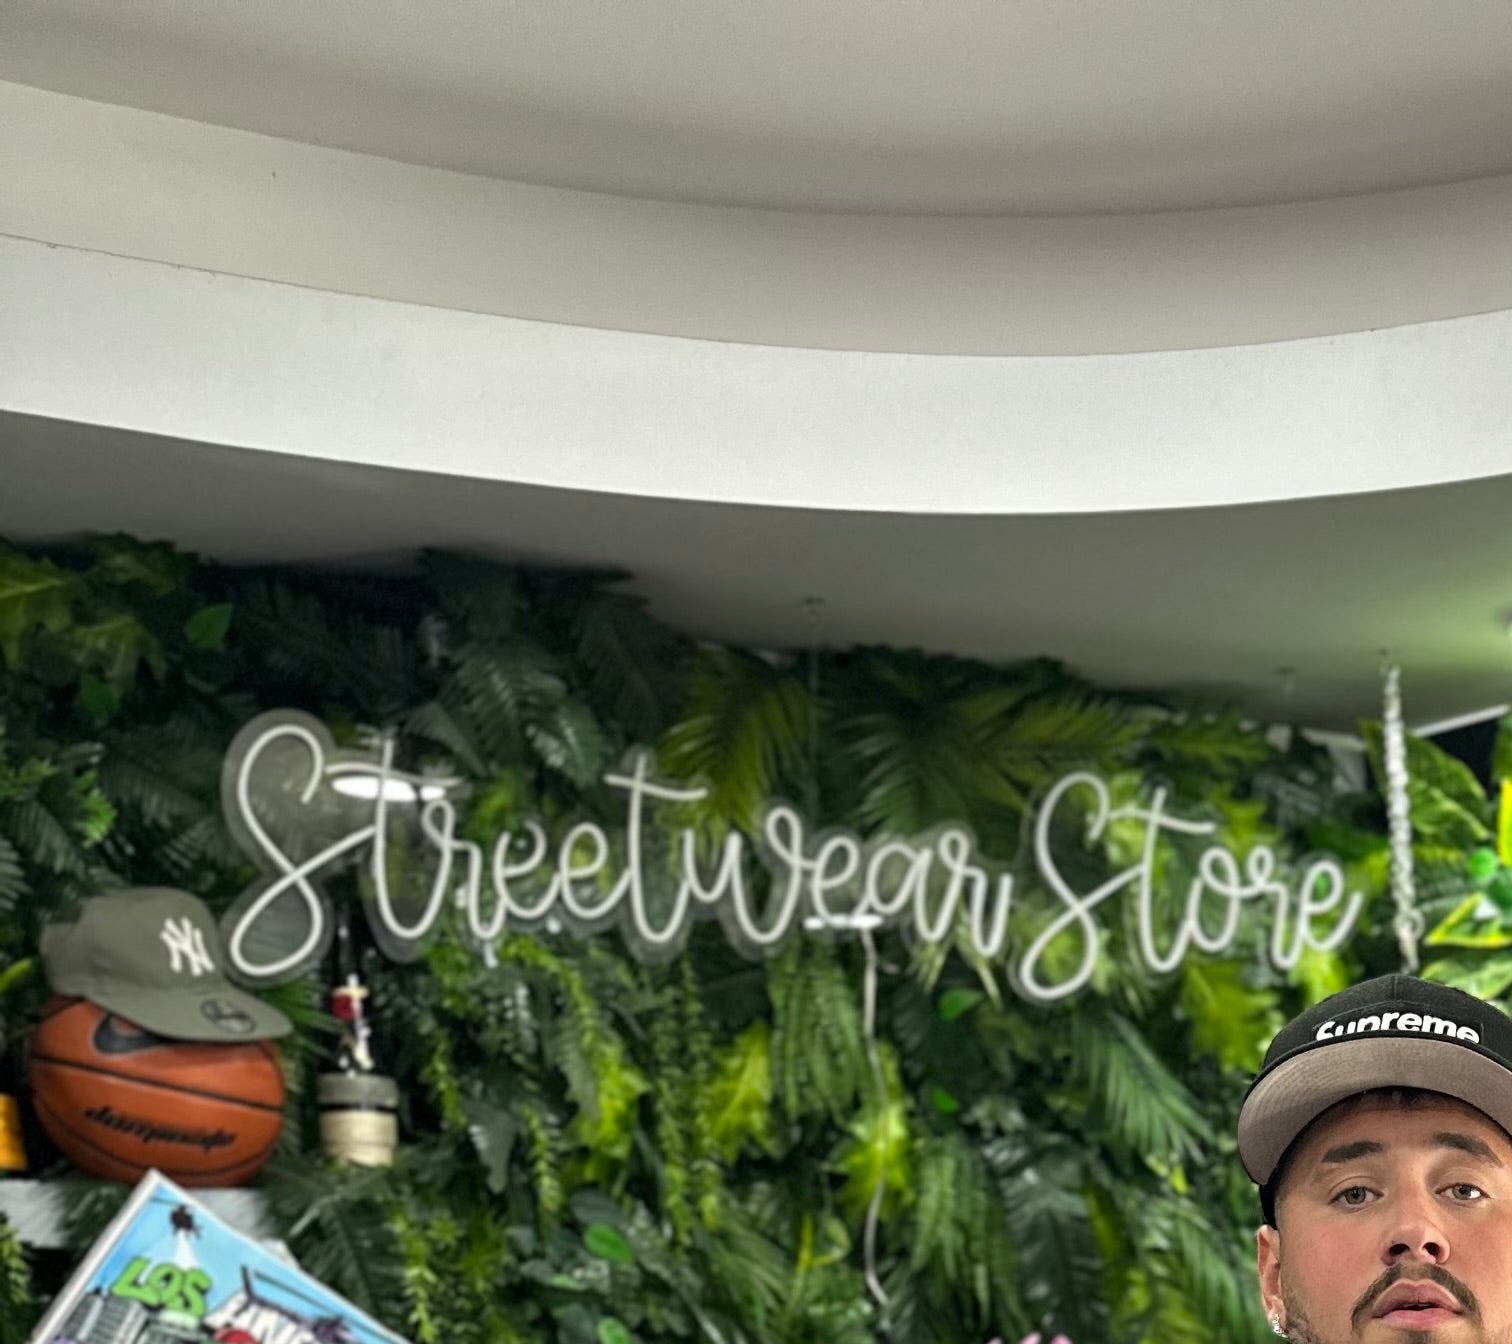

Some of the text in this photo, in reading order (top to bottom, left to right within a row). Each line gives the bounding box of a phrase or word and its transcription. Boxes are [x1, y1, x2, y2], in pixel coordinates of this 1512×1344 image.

[1019, 771, 1366, 1000] Store
[160, 916, 215, 976] NY
[111, 1256, 213, 1317] LOS
